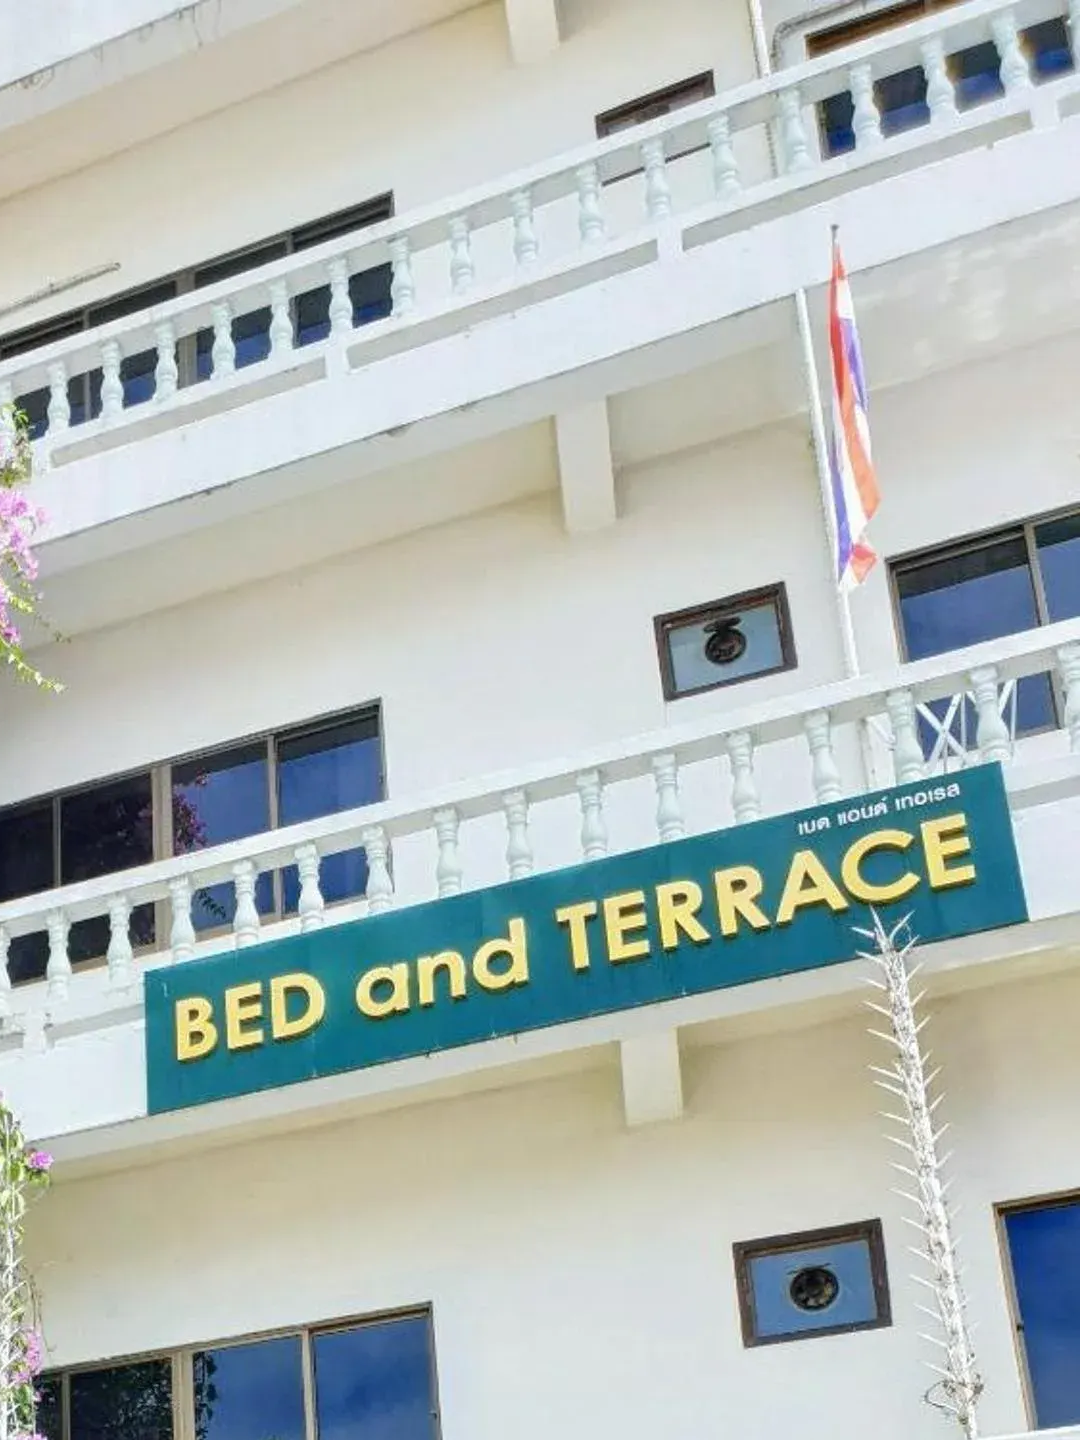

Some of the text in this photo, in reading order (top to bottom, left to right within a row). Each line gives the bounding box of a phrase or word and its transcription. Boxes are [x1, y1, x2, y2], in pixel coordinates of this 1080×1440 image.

[174, 813, 976, 1063] BED and TERRACE
